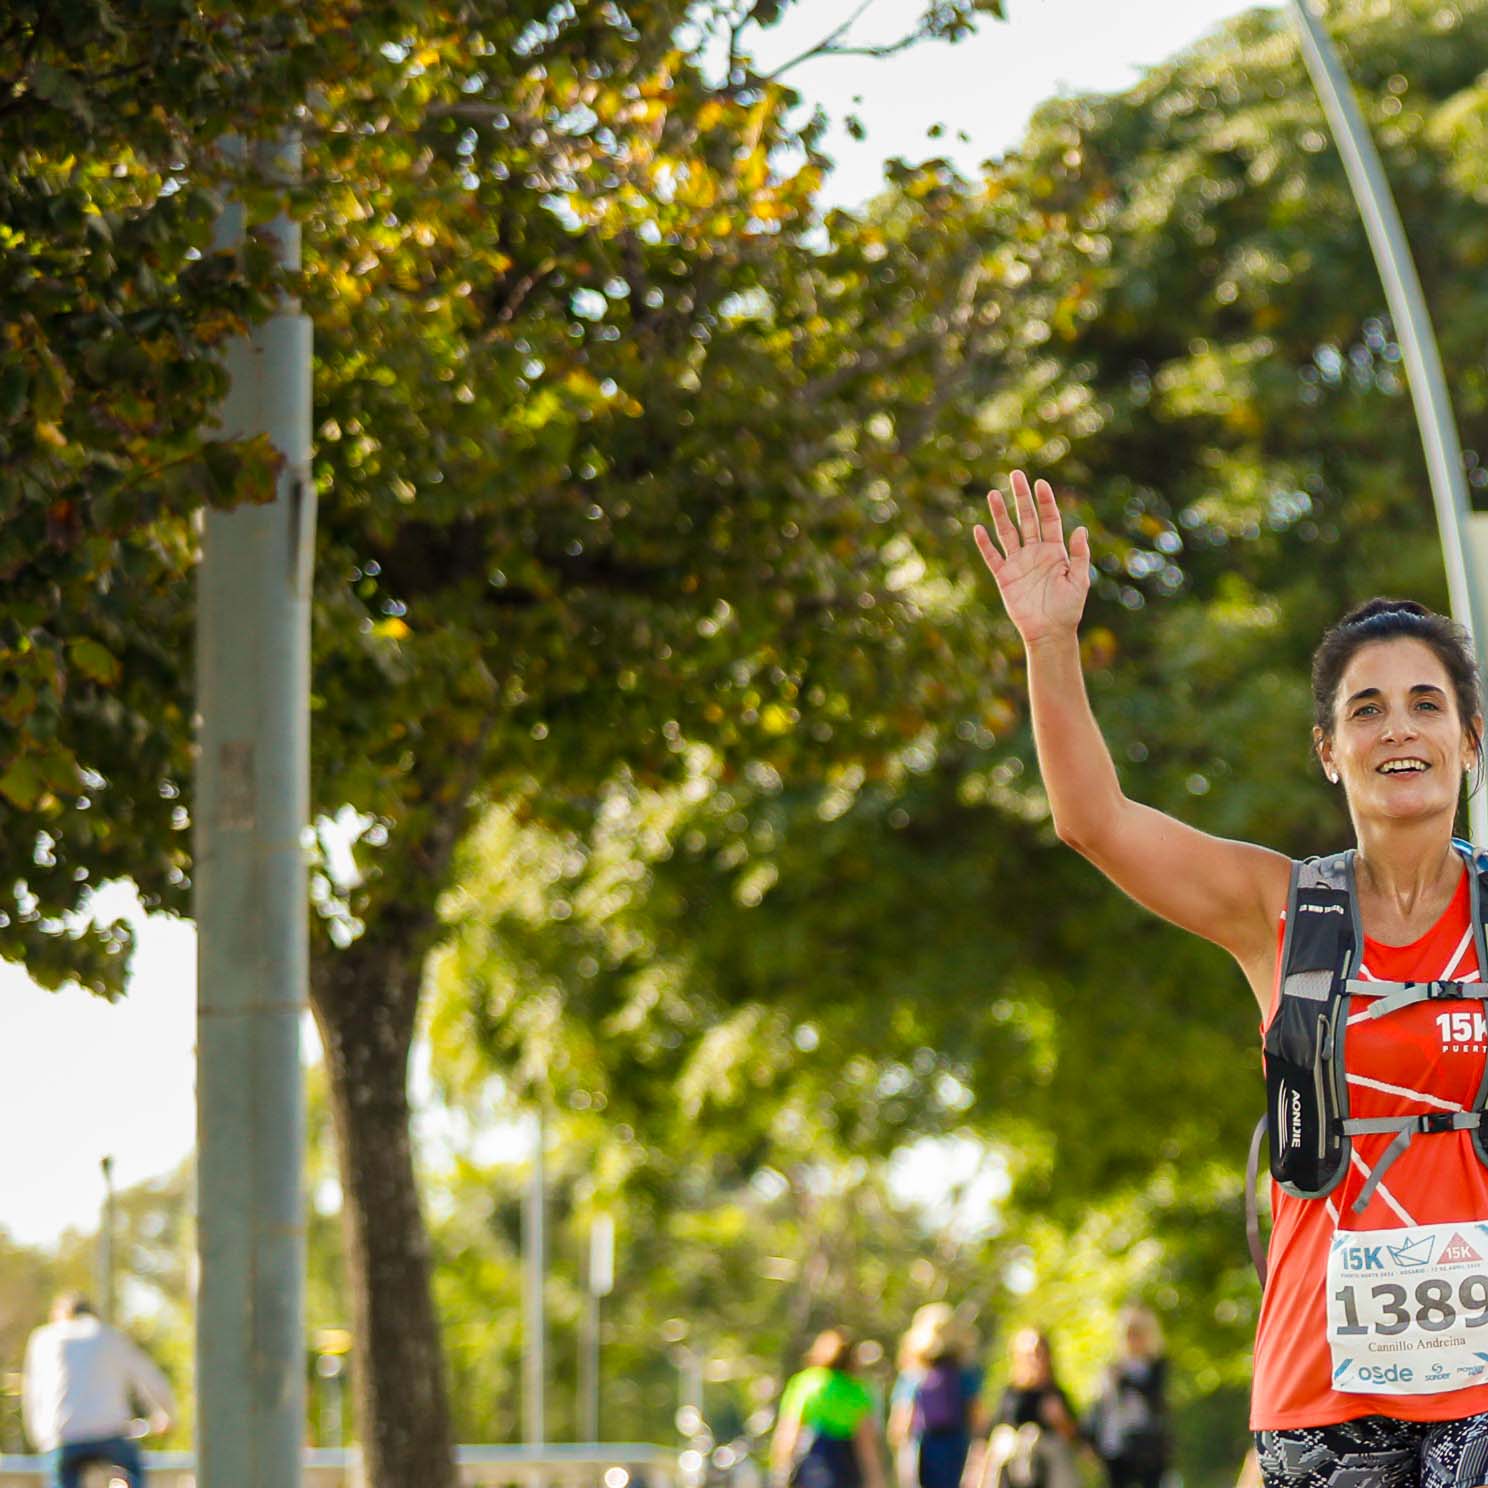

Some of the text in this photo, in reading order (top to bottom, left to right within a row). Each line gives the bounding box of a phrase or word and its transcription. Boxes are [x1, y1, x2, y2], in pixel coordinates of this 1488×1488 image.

[1291, 1089, 1302, 1148] AONIJIE
[1341, 1246, 1385, 1271] 15K
[1446, 1245, 1472, 1260] 15K
[1368, 1336, 1466, 1352] Cannillo Andreina
[1358, 1364, 1413, 1384] osde
